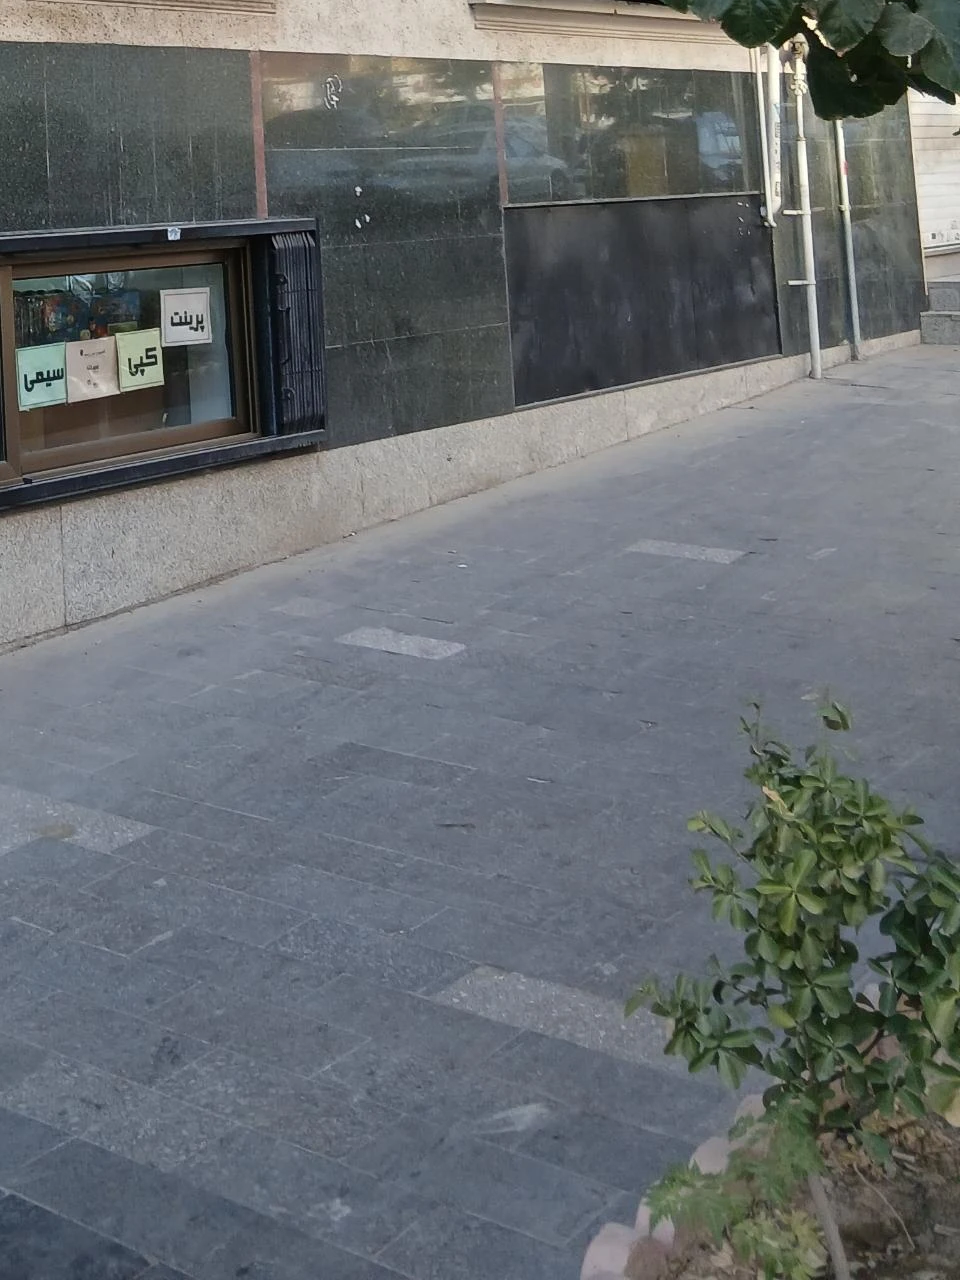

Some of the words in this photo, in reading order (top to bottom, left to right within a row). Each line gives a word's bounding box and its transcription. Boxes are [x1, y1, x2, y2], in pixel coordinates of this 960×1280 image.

[170, 311, 204, 332] پرینت
[127, 347, 158, 377] کپی
[24, 367, 64, 393] سیمی
